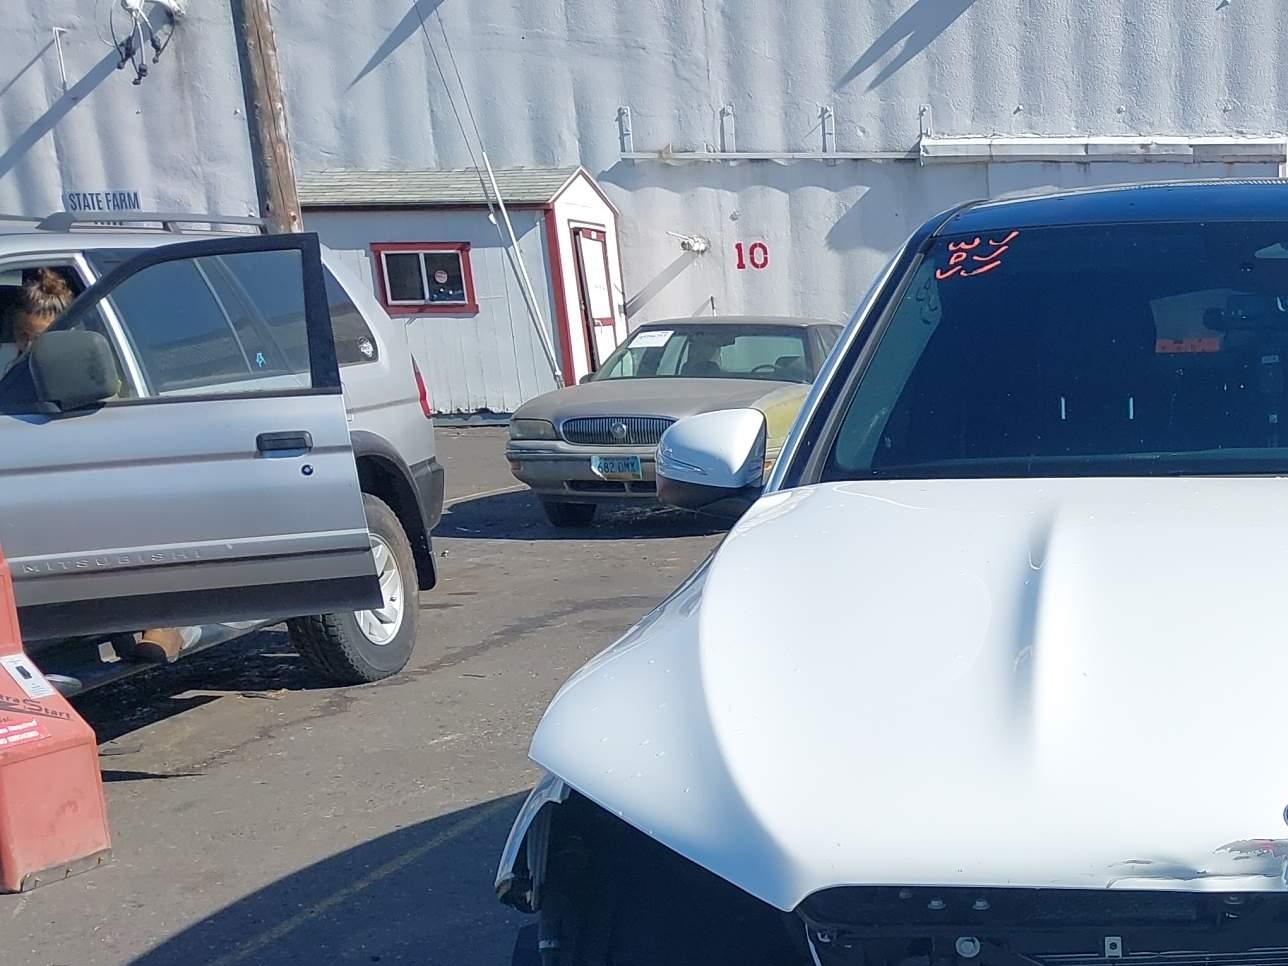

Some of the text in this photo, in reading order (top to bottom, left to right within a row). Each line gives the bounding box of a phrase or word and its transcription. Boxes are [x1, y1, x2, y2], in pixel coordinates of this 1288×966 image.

[68, 191, 141, 211] STATE FARM
[735, 242, 769, 269] 10
[597, 462, 615, 473] 682
[23, 550, 202, 574] MITSUBISHI
